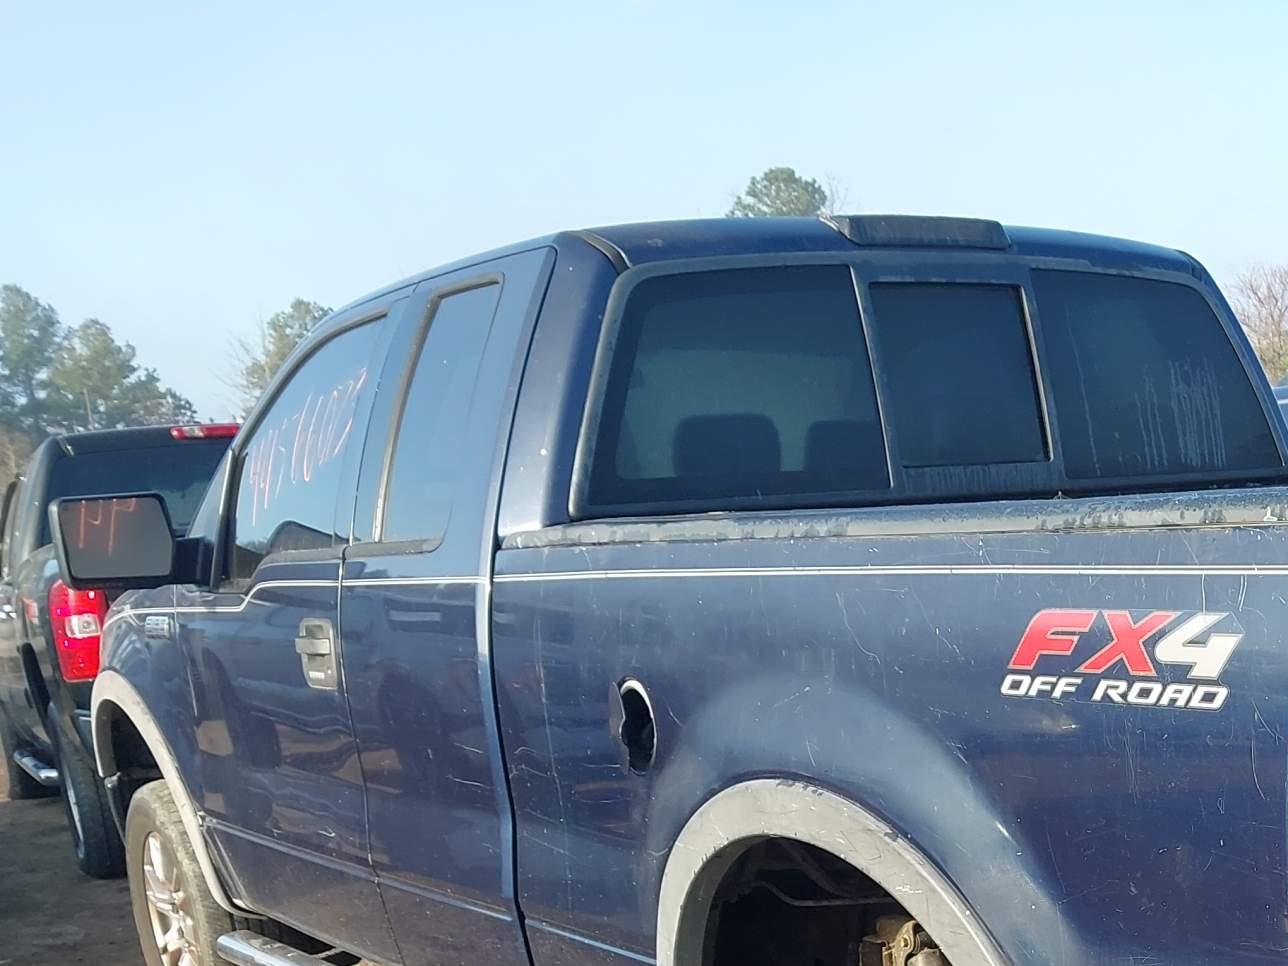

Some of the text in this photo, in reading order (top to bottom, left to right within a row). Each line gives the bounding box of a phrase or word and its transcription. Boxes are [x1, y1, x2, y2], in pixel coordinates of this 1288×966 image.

[1007, 608, 1245, 680] FX4
[1000, 674, 1230, 711] OFF ROAD
